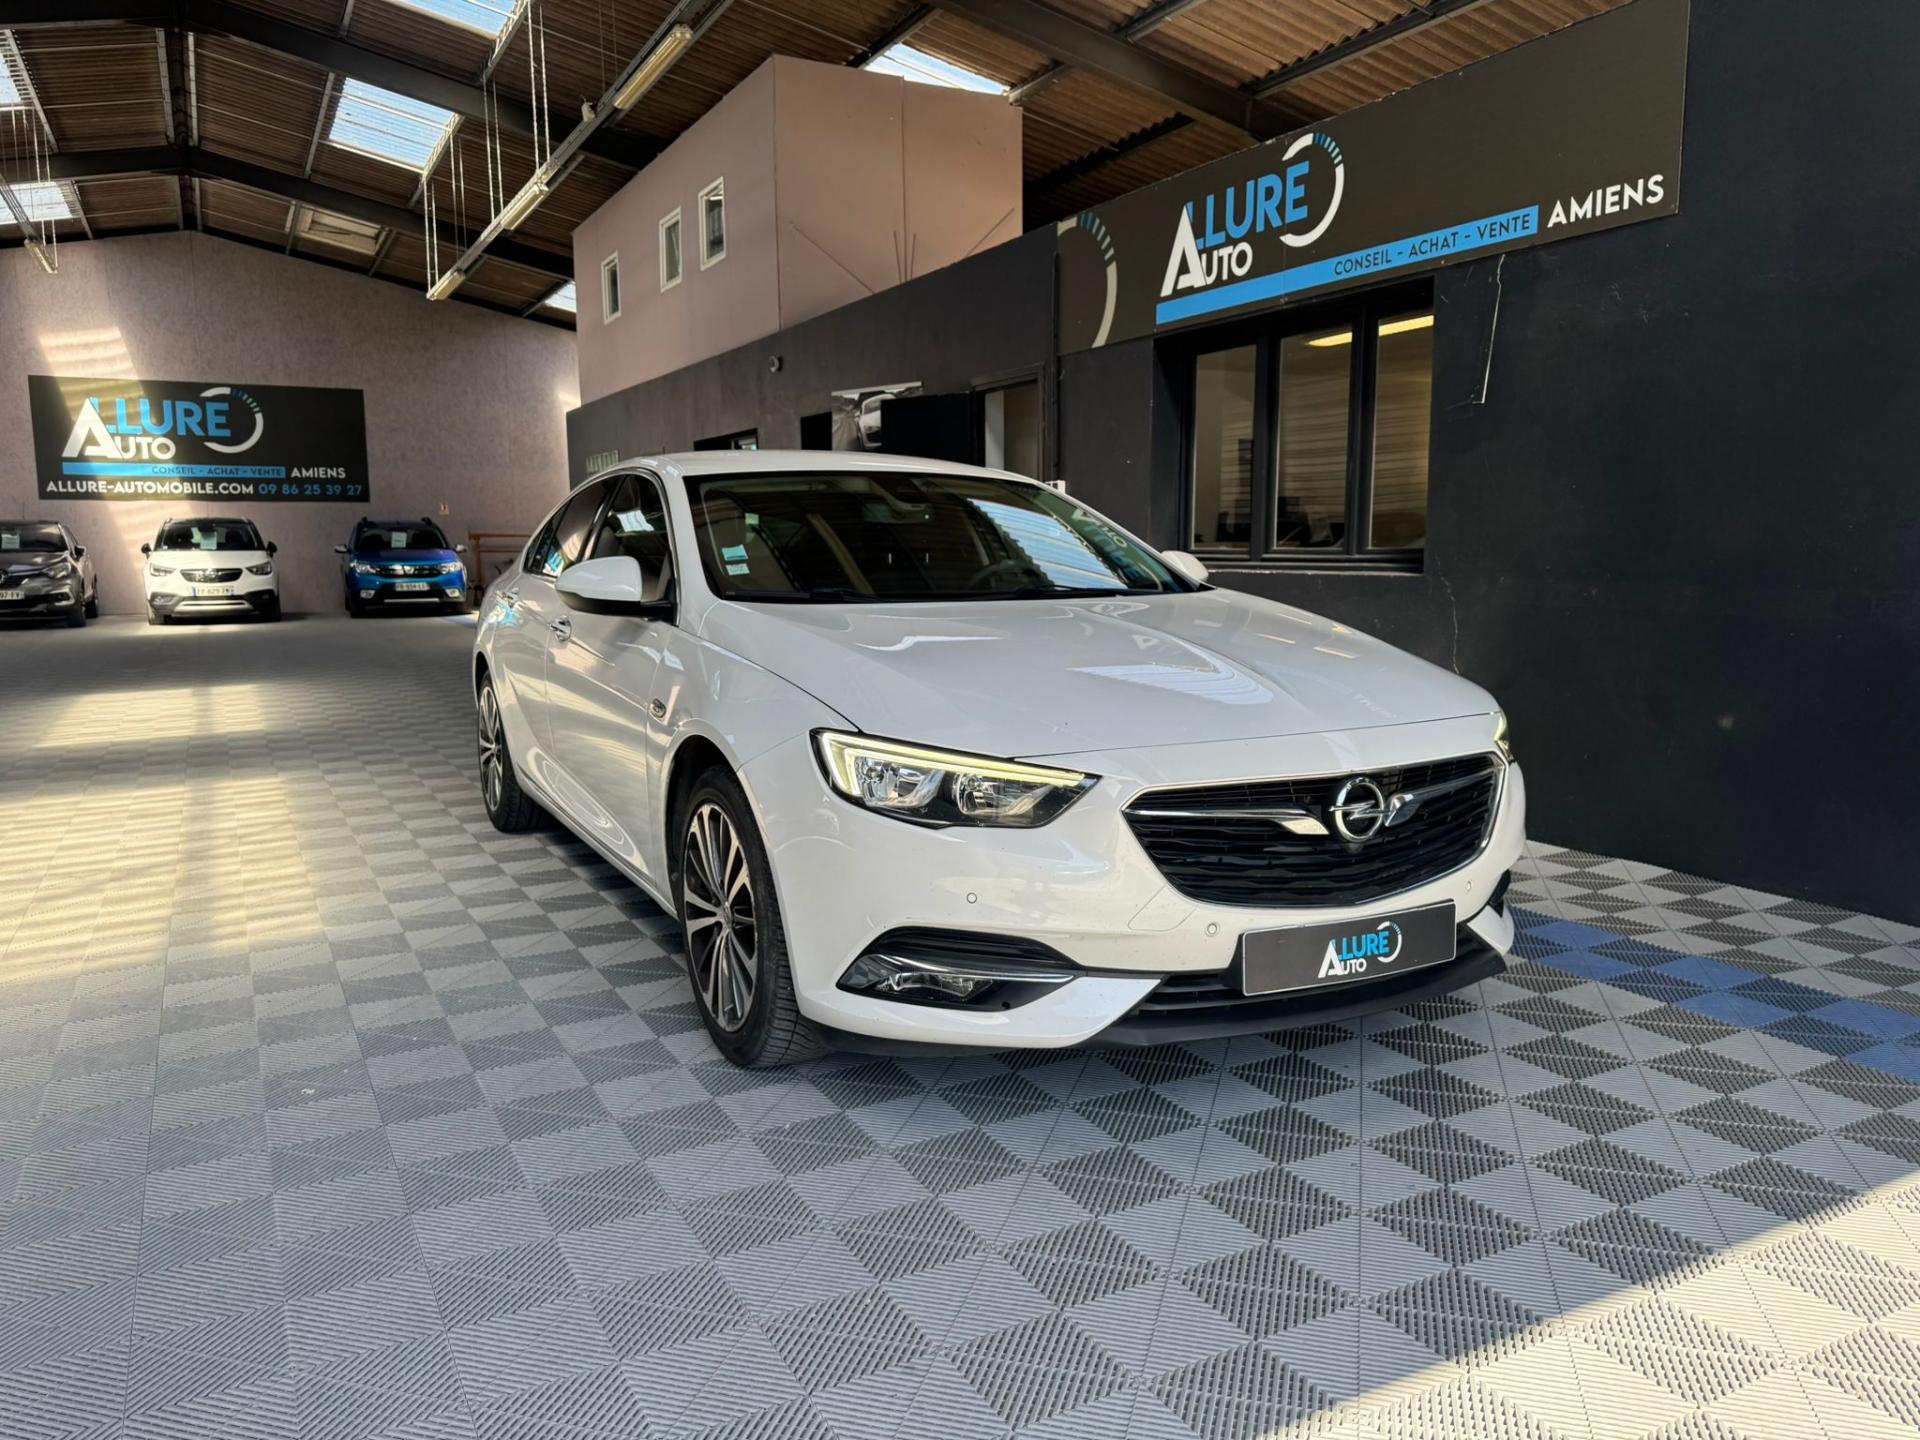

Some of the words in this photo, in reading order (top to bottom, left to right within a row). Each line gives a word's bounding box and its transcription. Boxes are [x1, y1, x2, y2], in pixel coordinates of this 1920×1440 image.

[1160, 160, 1310, 298] ALLURE
[1333, 245, 1393, 276] CONSEIL
[1408, 230, 1459, 260] ACHAT
[1476, 213, 1531, 240] VENTE
[1546, 173, 1665, 229] AMIENS
[62, 396, 232, 459] ALLURE
[46, 480, 254, 495] ALLURE-AUTOMOBILE.COM
[258, 483, 277, 495] 09
[281, 483, 299, 495] 86
[304, 484, 321, 496] 25
[326, 484, 342, 496] 39
[346, 485, 363, 496] 27
[151, 465, 196, 475] CONSEIL
[207, 467, 240, 476] ACHAT
[251, 468, 282, 477] VENTE
[290, 467, 346, 479] AMIENS
[1317, 930, 1390, 979] ALLURE
